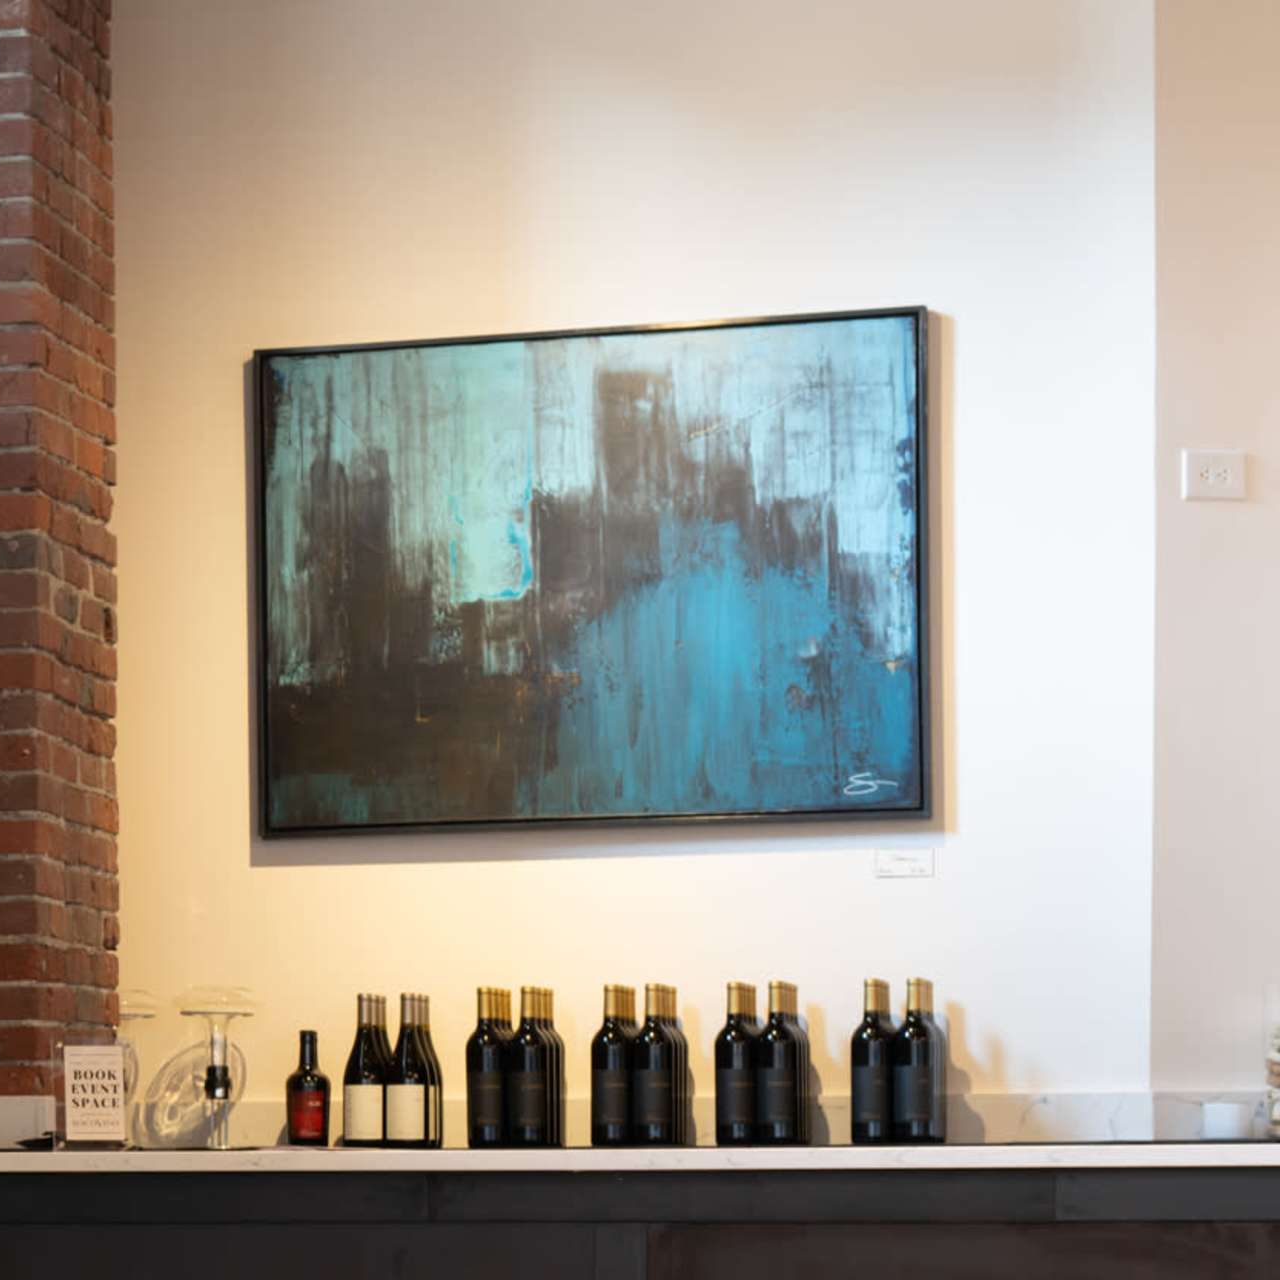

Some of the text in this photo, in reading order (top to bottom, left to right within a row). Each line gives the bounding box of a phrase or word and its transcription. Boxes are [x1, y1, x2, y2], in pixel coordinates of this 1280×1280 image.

[73, 1069, 117, 1081] BOOK
[71, 1083, 119, 1095] EVENT
[71, 1097, 121, 1109] SPACE
